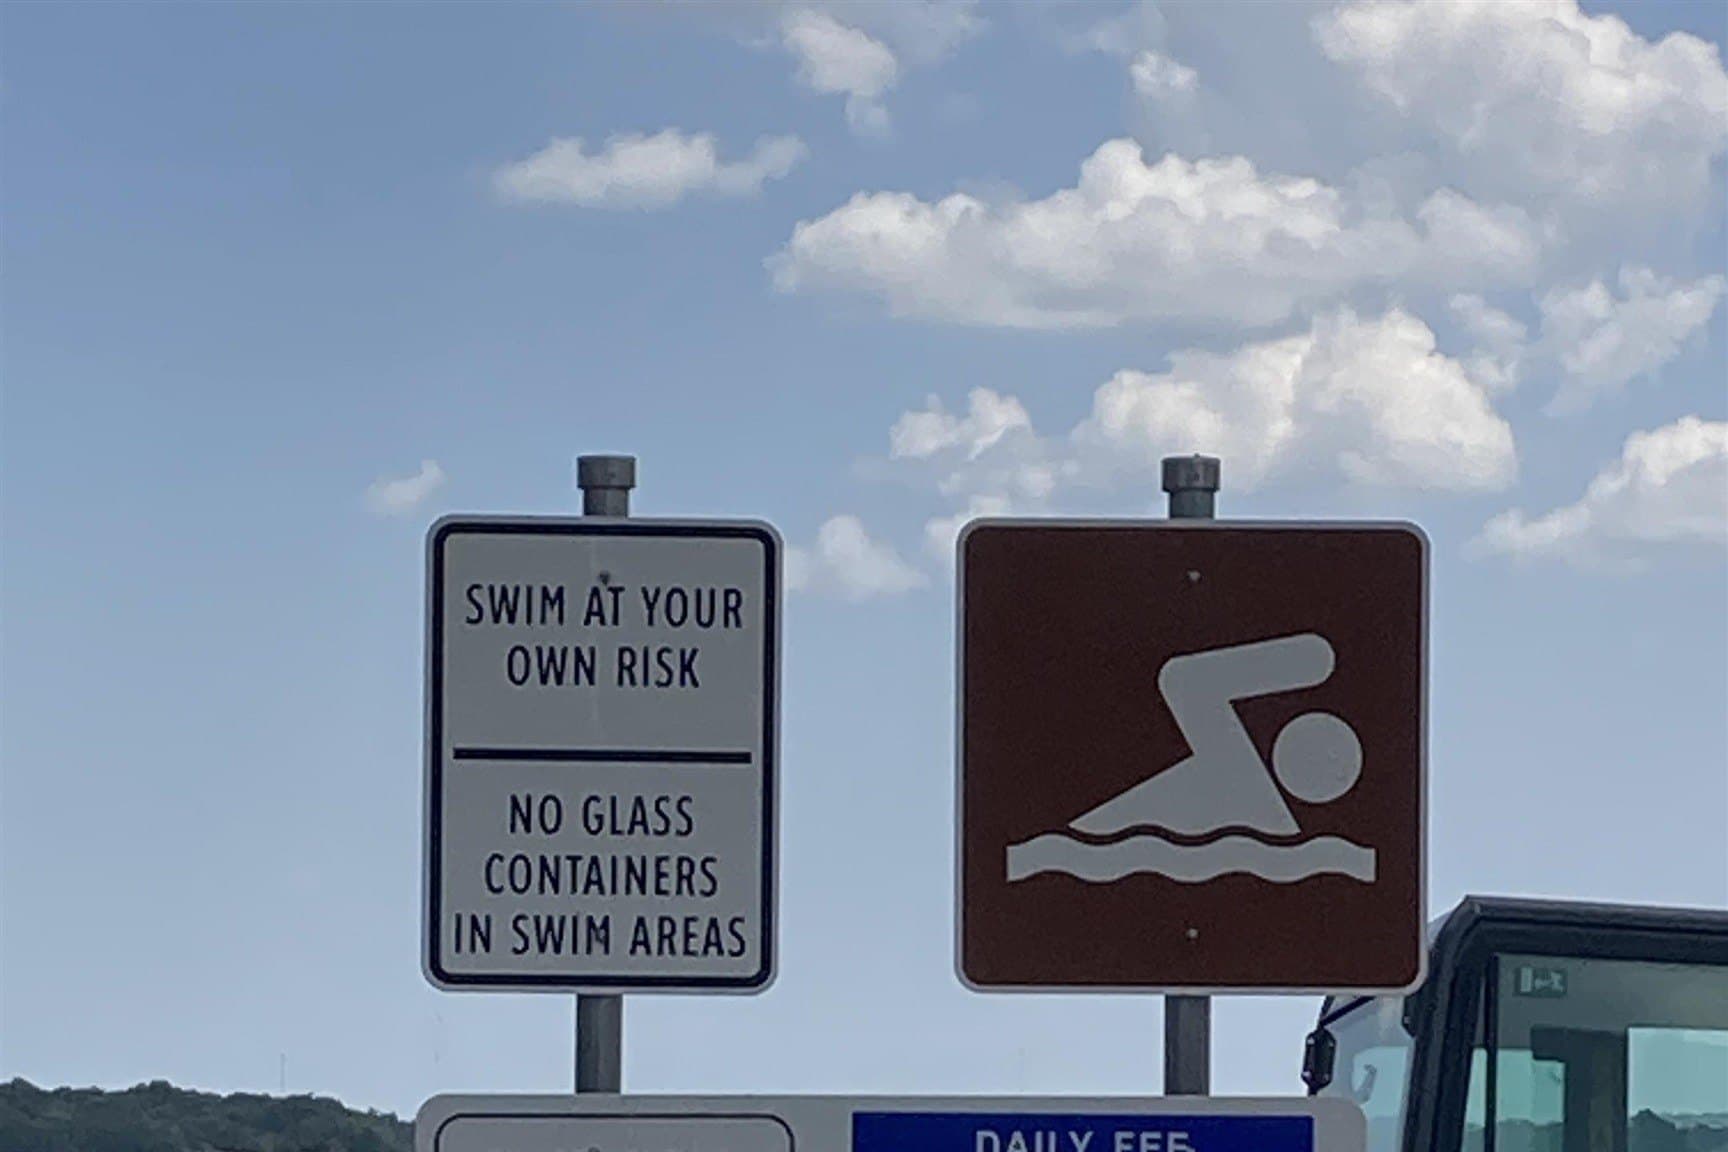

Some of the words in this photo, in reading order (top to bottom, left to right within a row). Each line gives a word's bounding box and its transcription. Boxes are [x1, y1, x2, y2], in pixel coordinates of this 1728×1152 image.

[465, 584, 565, 627] SWIM
[582, 586, 626, 627] AT
[641, 586, 743, 629] YOUR
[506, 645, 596, 687] OWN
[616, 646, 700, 689] RISK
[509, 795, 562, 836] NO
[582, 795, 694, 837] GLASS
[484, 852, 718, 897] CONTAINERS
[454, 913, 492, 955] IN
[511, 914, 611, 957] SWIM
[629, 916, 746, 958] AREAS
